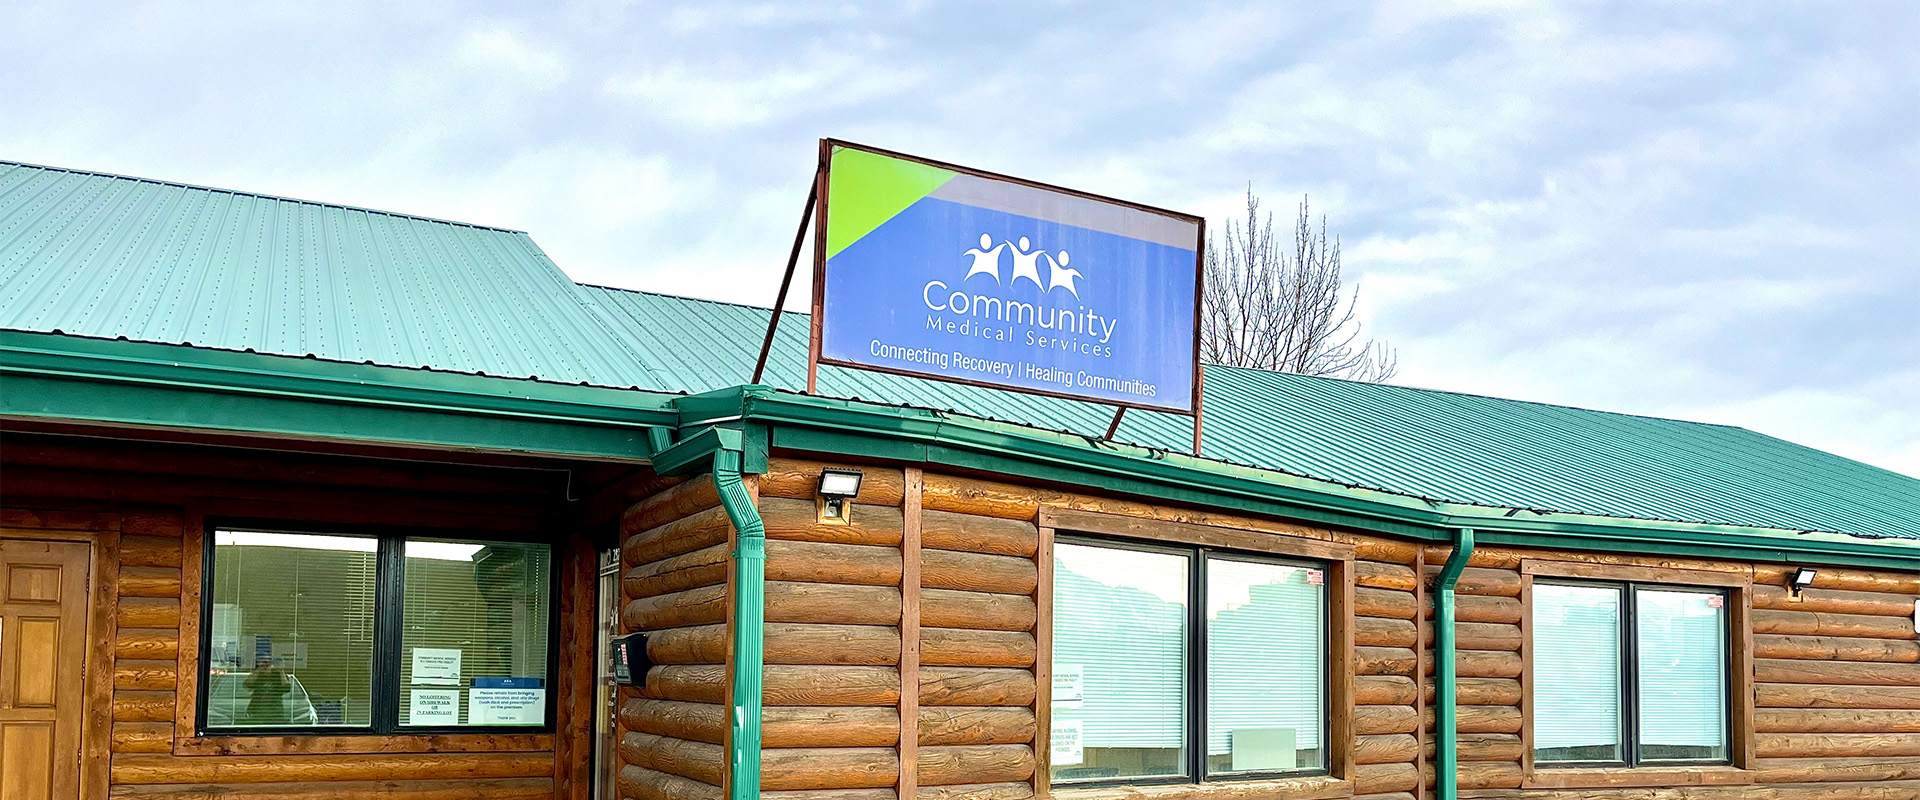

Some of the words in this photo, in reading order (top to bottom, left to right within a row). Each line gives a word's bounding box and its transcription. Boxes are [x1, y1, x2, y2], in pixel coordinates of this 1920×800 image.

[923, 280, 1117, 344] Community
[926, 314, 1013, 342] Medical
[1026, 330, 1112, 358] Services
[870, 340, 948, 369] Connecting
[953, 351, 1014, 379] Recovery
[1026, 363, 1073, 388] Healing
[1078, 370, 1156, 397] Communities
